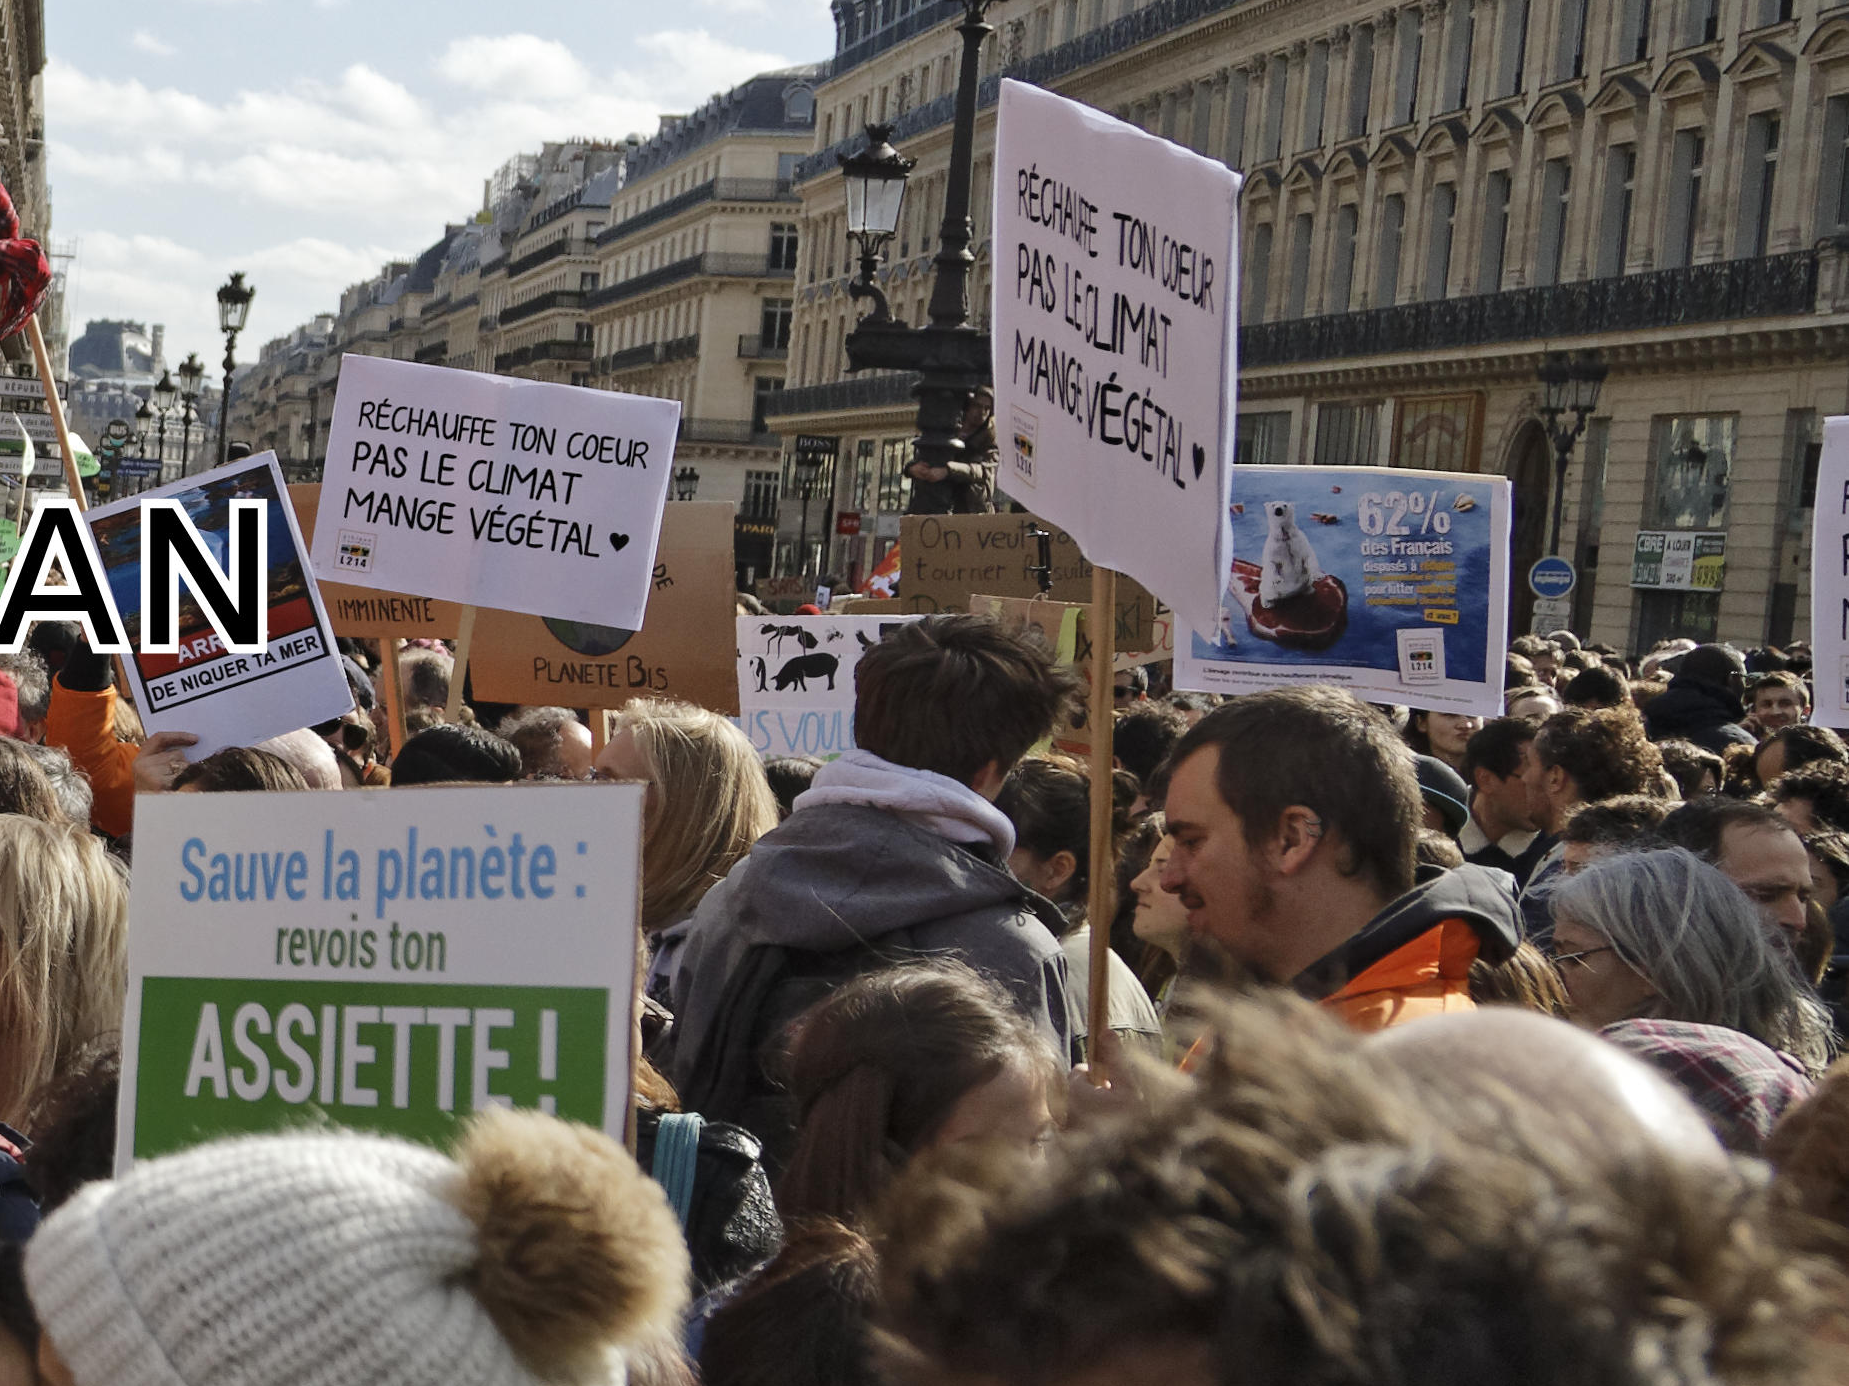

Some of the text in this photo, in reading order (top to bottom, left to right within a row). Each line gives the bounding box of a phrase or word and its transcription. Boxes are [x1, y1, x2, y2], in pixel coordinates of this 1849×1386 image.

[1113, 211, 1157, 280] TON
[1161, 234, 1215, 315] COEUR
[1017, 241, 1172, 380] PAS LE CLIMAT
[358, 398, 650, 469] RÉCHAUFFE TON COEUR
[1013, 328, 1186, 490] MANGE VÉGÉTAL
[351, 441, 583, 505] PAS LE CLIMAT
[799, 437, 832, 449] BOSS
[343, 488, 600, 559] MANGE VÉGÉTAL
[918, 517, 962, 550] On
[1357, 490, 1452, 536] 62%
[339, 555, 367, 569] L214
[916, 560, 1006, 582] tourner
[1360, 537, 1455, 557] des Français
[151, 635, 319, 702] DE NIQUER TA MER
[178, 837, 309, 904] Sauve
[323, 828, 360, 902] la
[375, 824, 557, 920] planète
[275, 914, 447, 972] revois ton
[184, 1001, 514, 1113] ASSIETTE
